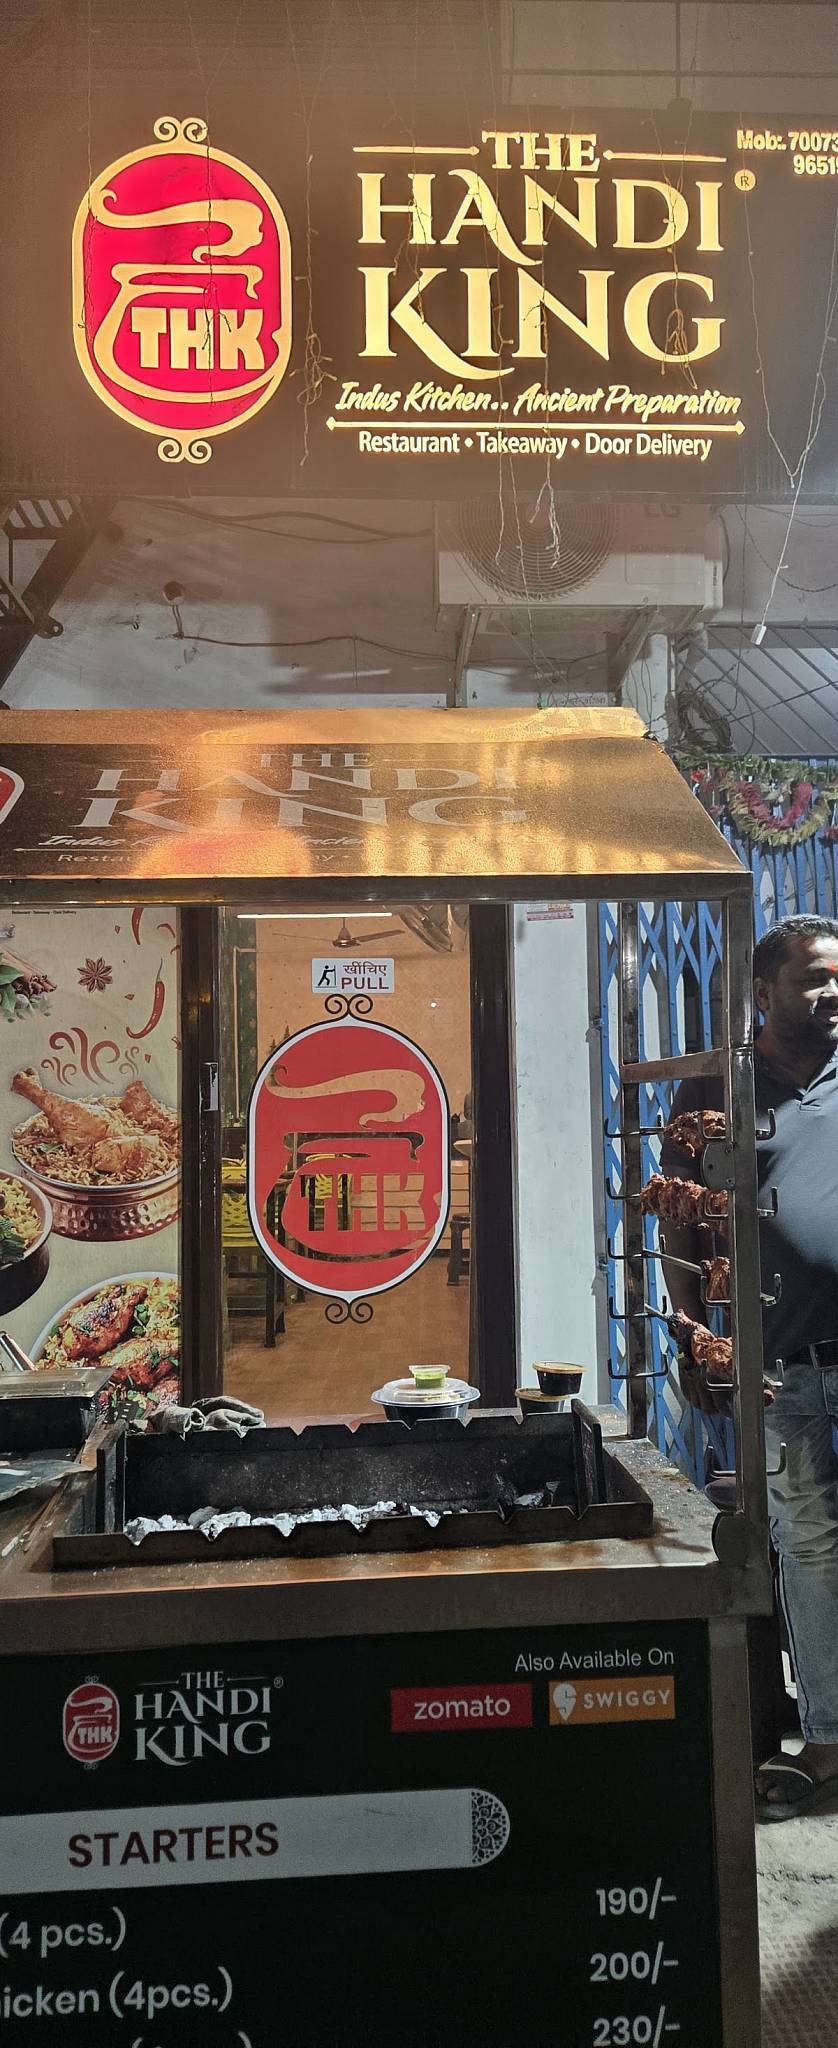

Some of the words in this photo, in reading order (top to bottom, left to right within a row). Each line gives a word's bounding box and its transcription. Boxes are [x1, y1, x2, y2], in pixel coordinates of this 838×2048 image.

[481, 130, 600, 172] THE
[793, 154, 838, 175] 9651
[357, 169, 725, 265] HANDI
[131, 306, 265, 370] THK
[357, 266, 727, 380] KING
[335, 382, 401, 412] Indus
[512, 382, 605, 416] Ancient
[603, 384, 741, 423] Preparation
[359, 430, 460, 454] Restaurant
[476, 431, 568, 460] Takeaway
[585, 432, 633, 455] Door
[636, 433, 713, 462] Delivery
[68, 796, 534, 833] KING
[38, 835, 125, 846] Indus
[341, 977, 389, 990] PULL
[343, 960, 387, 976] खींचिए
[299, 1173, 426, 1232] THK
[181, 1671, 225, 1690] THE
[514, 1653, 554, 1673] Also
[559, 1649, 642, 1670] Available
[648, 1647, 675, 1666] On
[134, 1687, 272, 1724] HANDI
[413, 1694, 512, 1720] zomato
[583, 1689, 671, 1709] SWIGGY
[77, 1726, 113, 1745] THK
[134, 1719, 272, 1766] KING
[68, 1822, 279, 1869] STARTERS
[596, 1876, 677, 1920] 190/-
[0, 1912, 31, 1958] (4
[41, 1906, 126, 1958] pcs.)
[590, 1941, 679, 1985] 200/-
[0, 1985, 100, 2018] icken
[109, 1966, 233, 2020] (4pcs.)
[593, 2004, 681, 2048] 230/-
